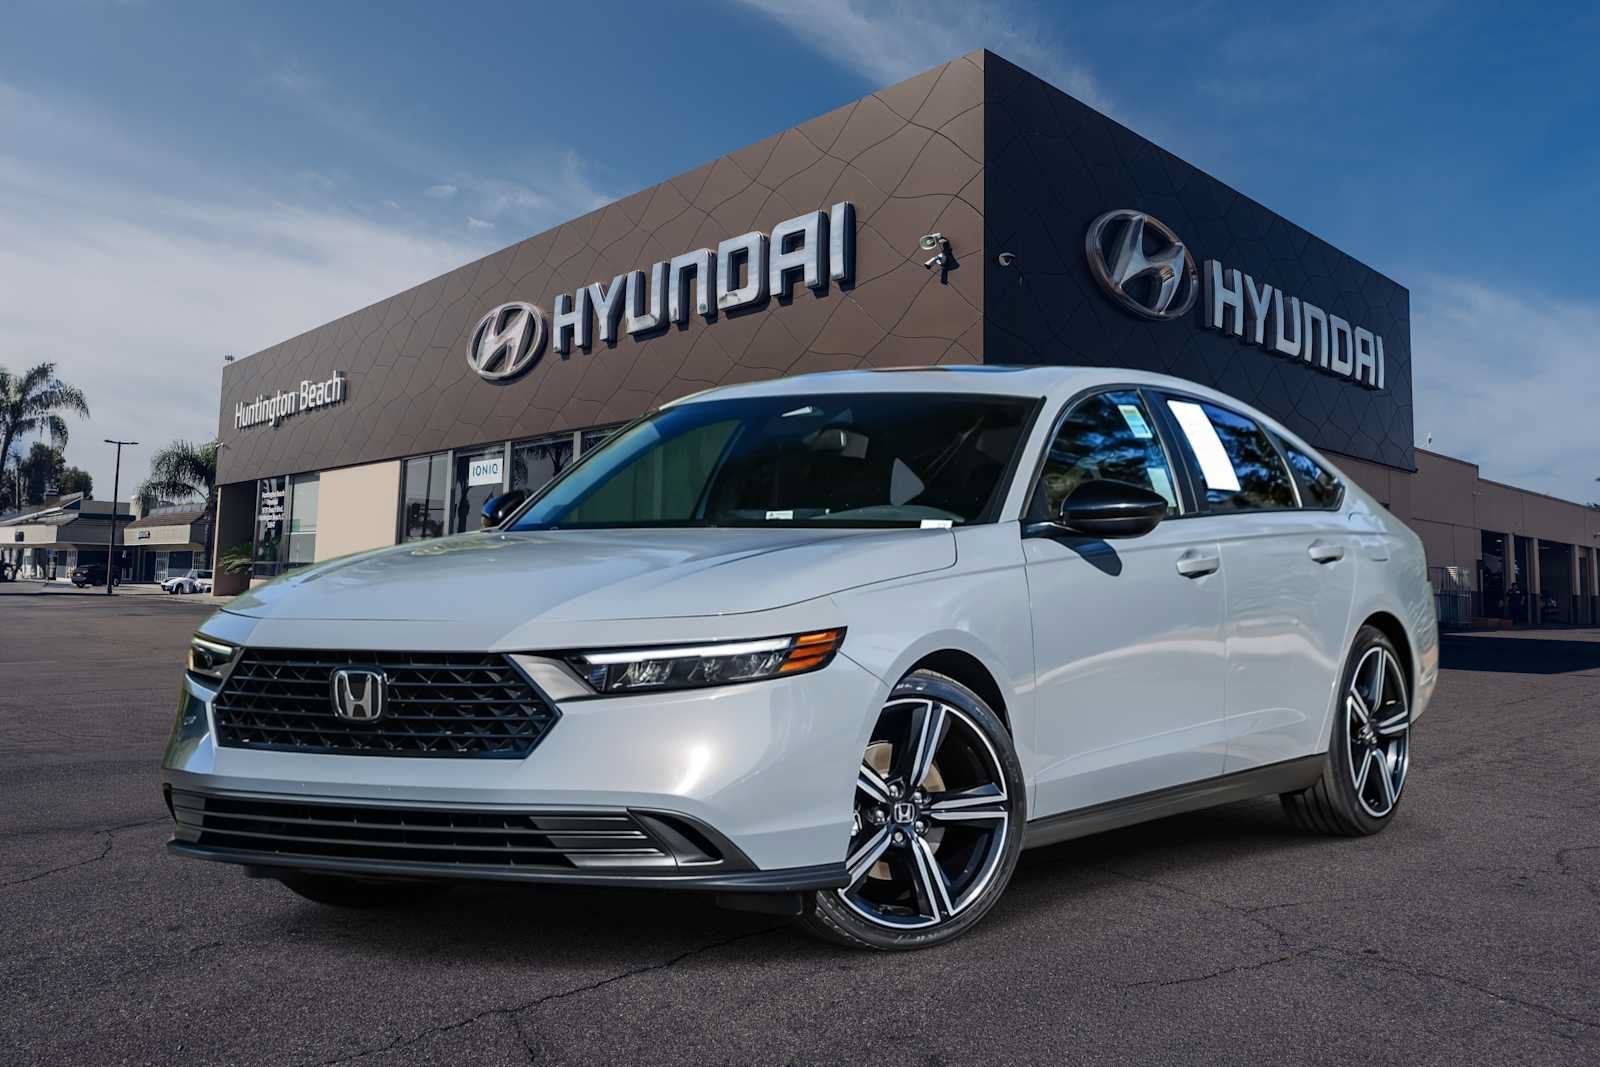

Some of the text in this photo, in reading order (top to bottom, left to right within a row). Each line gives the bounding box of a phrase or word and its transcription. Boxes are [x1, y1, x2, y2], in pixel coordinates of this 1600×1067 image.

[552, 201, 852, 354] HYUNDAI
[1205, 259, 1385, 390] HYUNDAI
[234, 370, 344, 430] Huntington Beach
